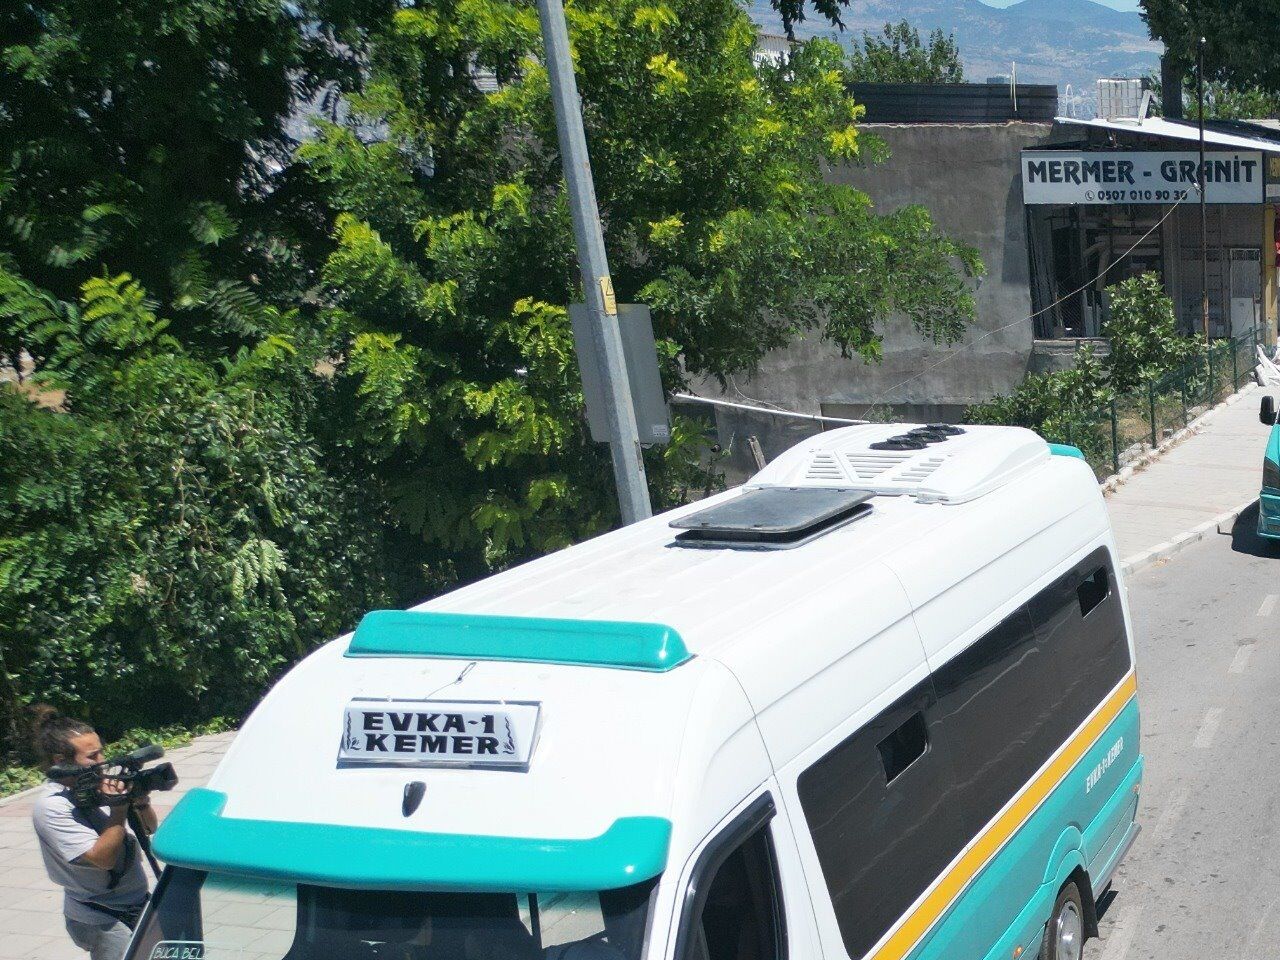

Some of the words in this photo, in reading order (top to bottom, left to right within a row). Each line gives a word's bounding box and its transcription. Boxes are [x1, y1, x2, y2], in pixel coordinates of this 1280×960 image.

[1027, 160, 1135, 185] MERMER
[1143, 169, 1152, 177] -
[1160, 155, 1257, 183] GRANİT
[1097, 190, 1125, 201] 0507
[1130, 190, 1151, 201] 010
[361, 711, 496, 735] EVKA-1
[364, 733, 500, 755] KEMER
[153, 947, 179, 959] BUCA
